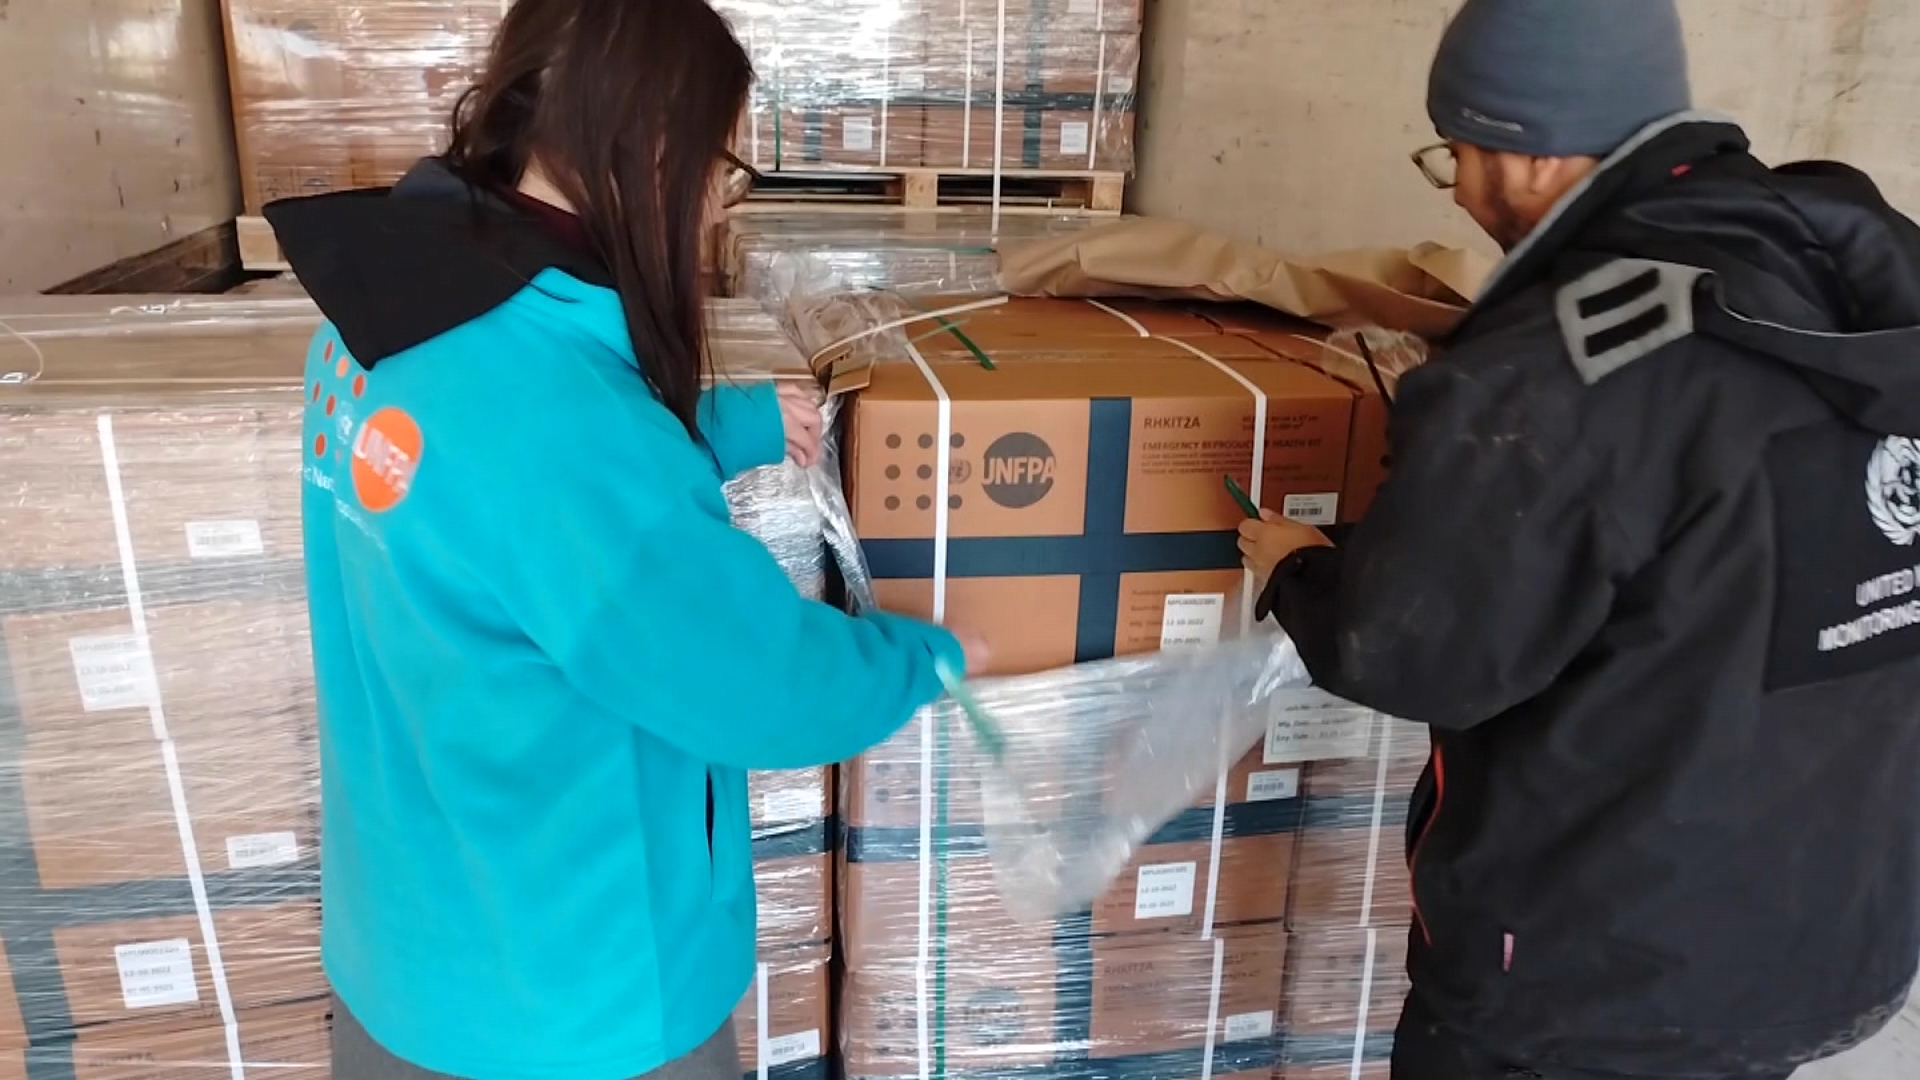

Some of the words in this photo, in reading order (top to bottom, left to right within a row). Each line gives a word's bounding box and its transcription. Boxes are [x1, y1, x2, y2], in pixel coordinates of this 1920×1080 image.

[1142, 415, 1202, 430] RHKIT2A
[353, 420, 417, 496] UNFPA
[981, 455, 1056, 486] UNFPA
[1855, 568, 1913, 607] UNITED
